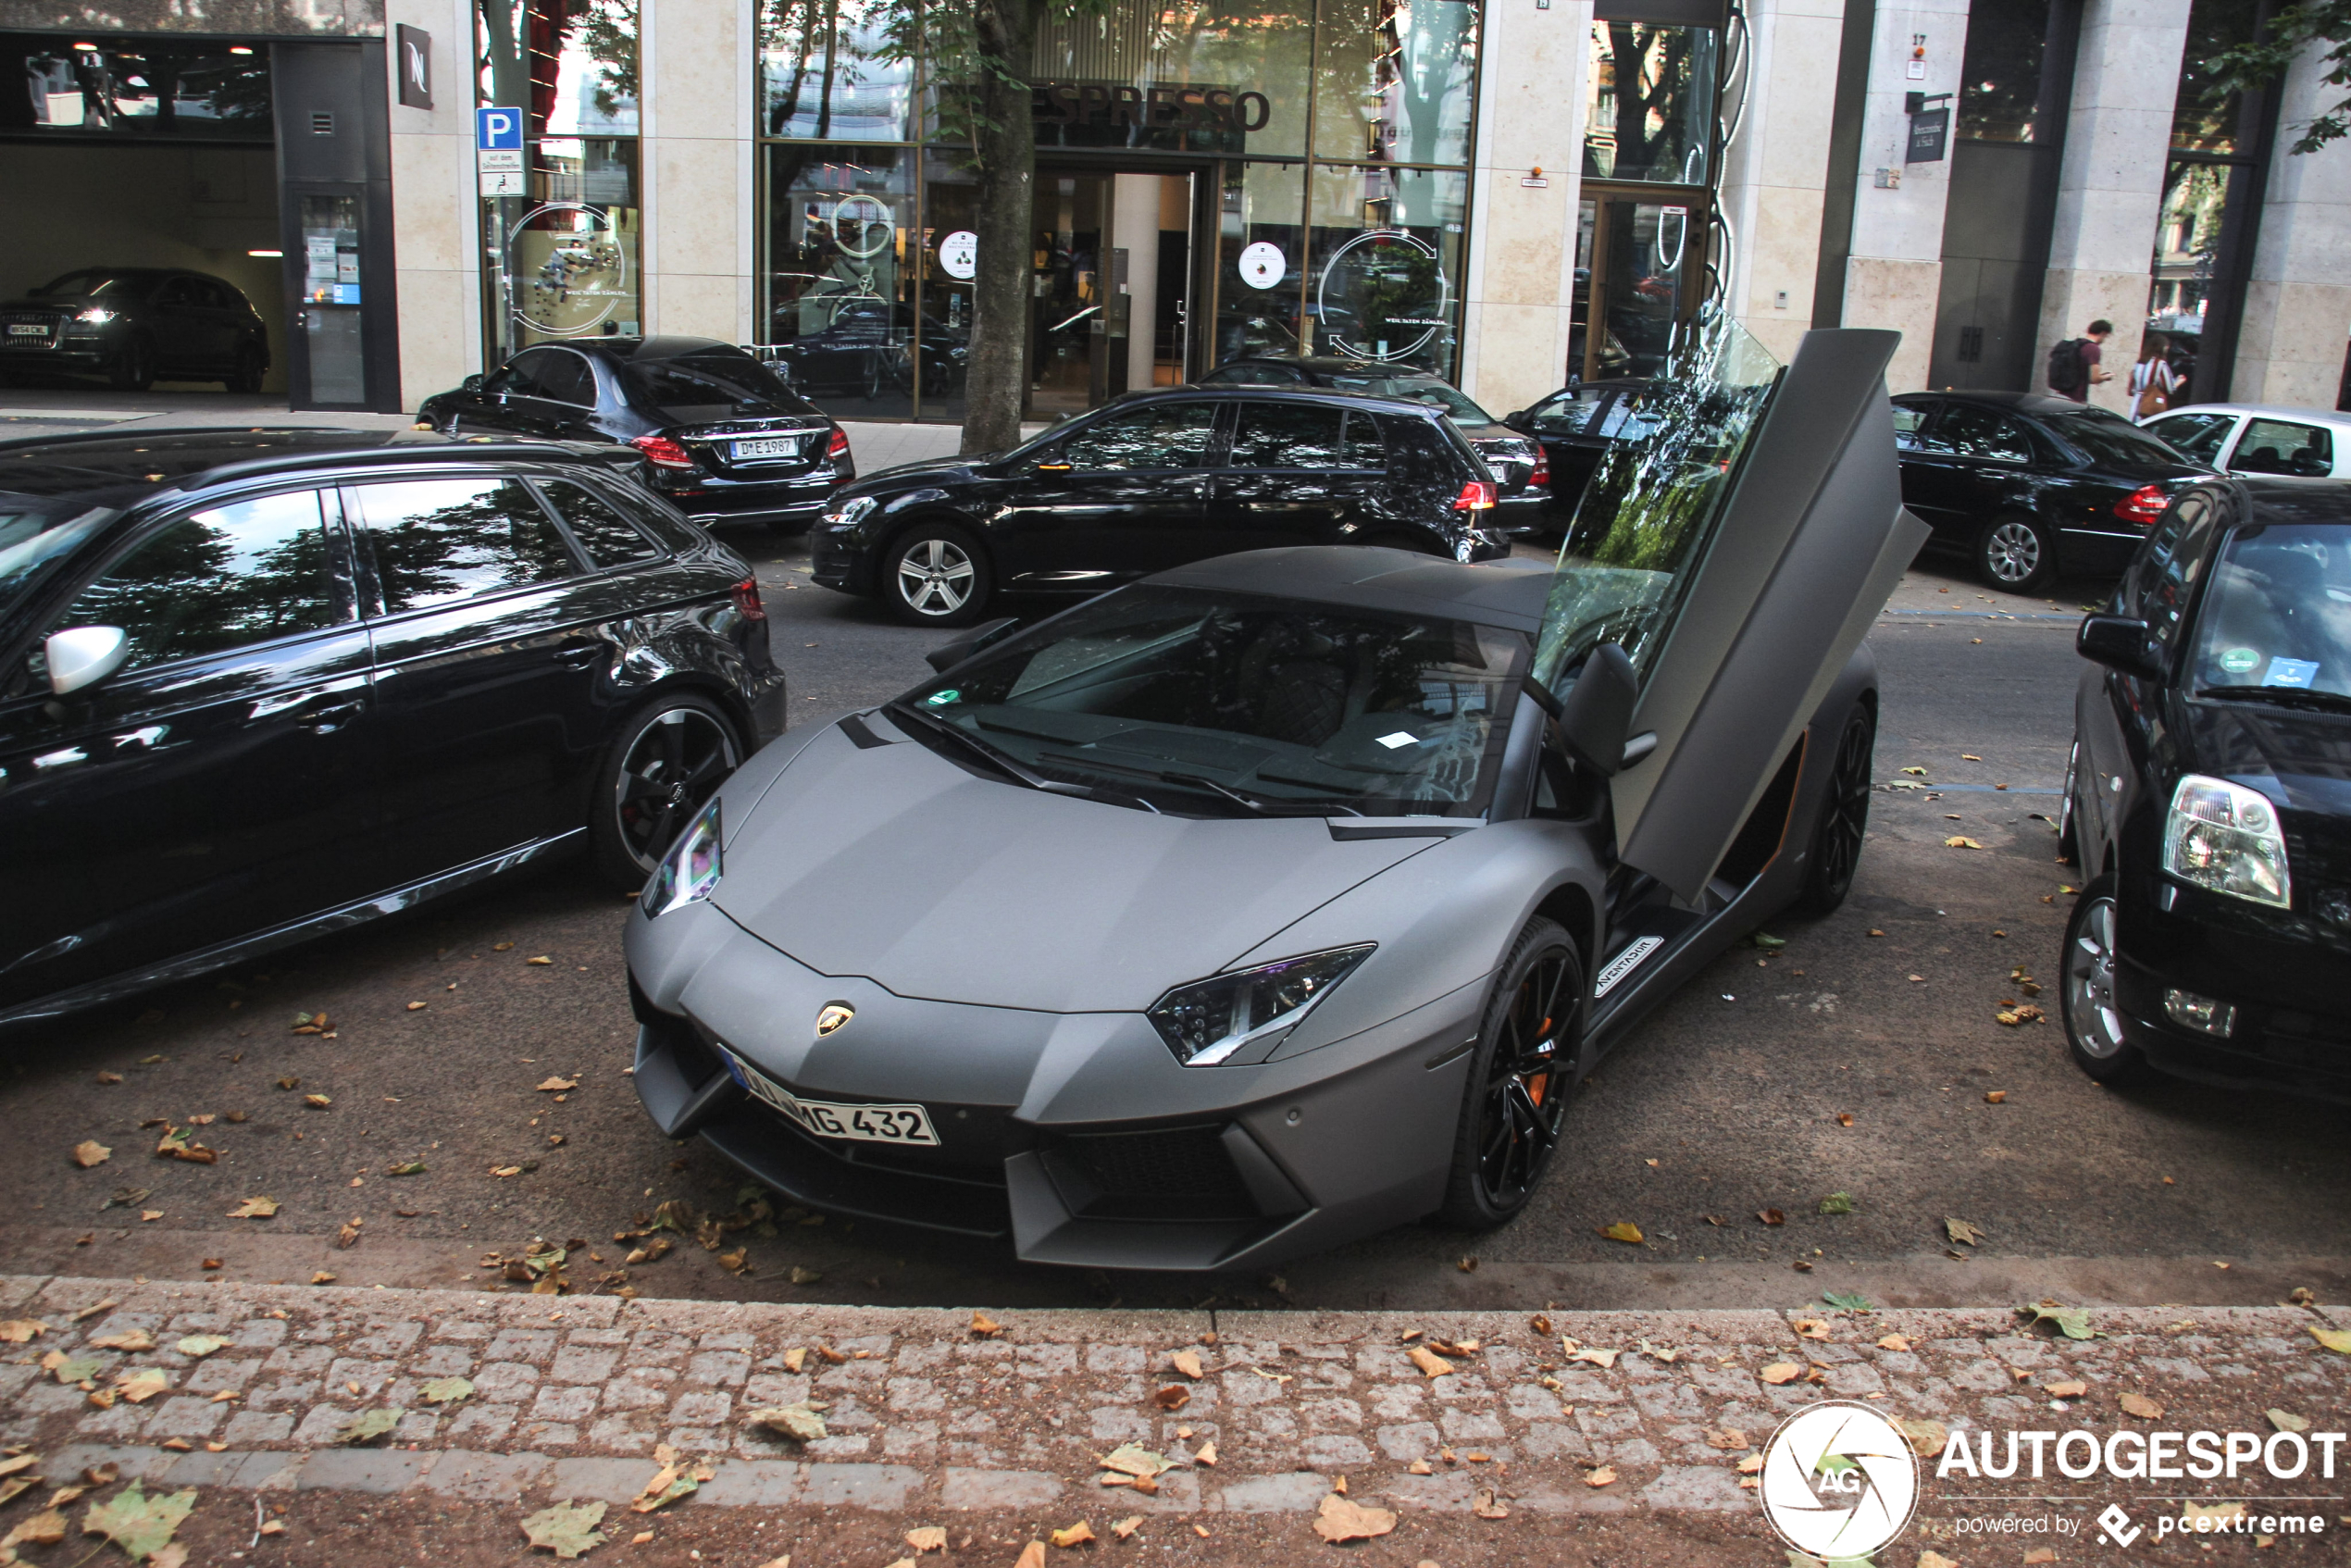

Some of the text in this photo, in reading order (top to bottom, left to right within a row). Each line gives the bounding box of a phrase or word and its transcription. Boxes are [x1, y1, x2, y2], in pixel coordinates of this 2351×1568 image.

[1913, 35, 1927, 45] 17
[487, 114, 512, 147] P
[1597, 941, 1651, 988] AVENTADOR
[852, 1110, 931, 1140] 432
